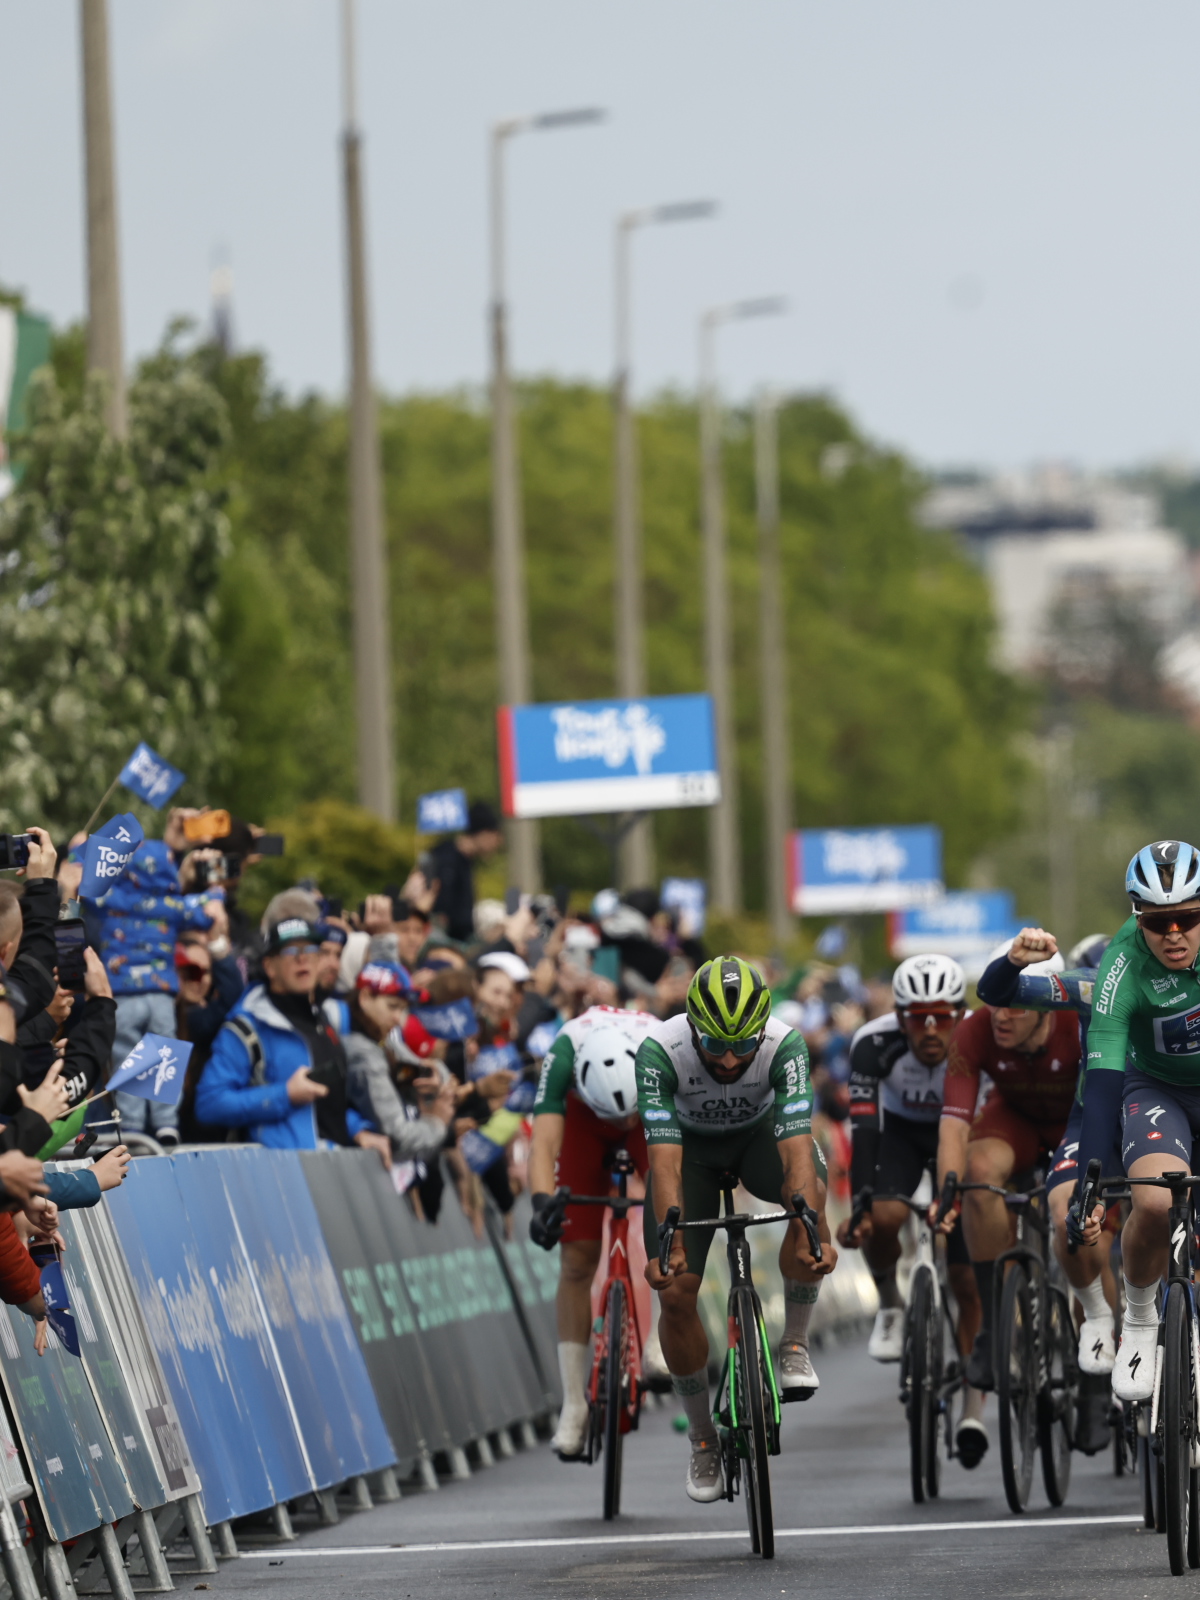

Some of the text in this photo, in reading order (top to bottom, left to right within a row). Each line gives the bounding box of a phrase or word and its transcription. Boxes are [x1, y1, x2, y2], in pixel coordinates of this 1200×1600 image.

[1096, 951, 1127, 1015] Europcar
[643, 1067, 662, 1107] ALEA
[783, 1058, 798, 1098] RGA
[796, 1054, 807, 1095] SEGUROS
[645, 1111, 671, 1119] KMC
[689, 1105, 760, 1119] RURAL
[701, 1097, 754, 1111] CAJA
[784, 1101, 809, 1112] KMC
[737, 1248, 745, 1279] MMR
